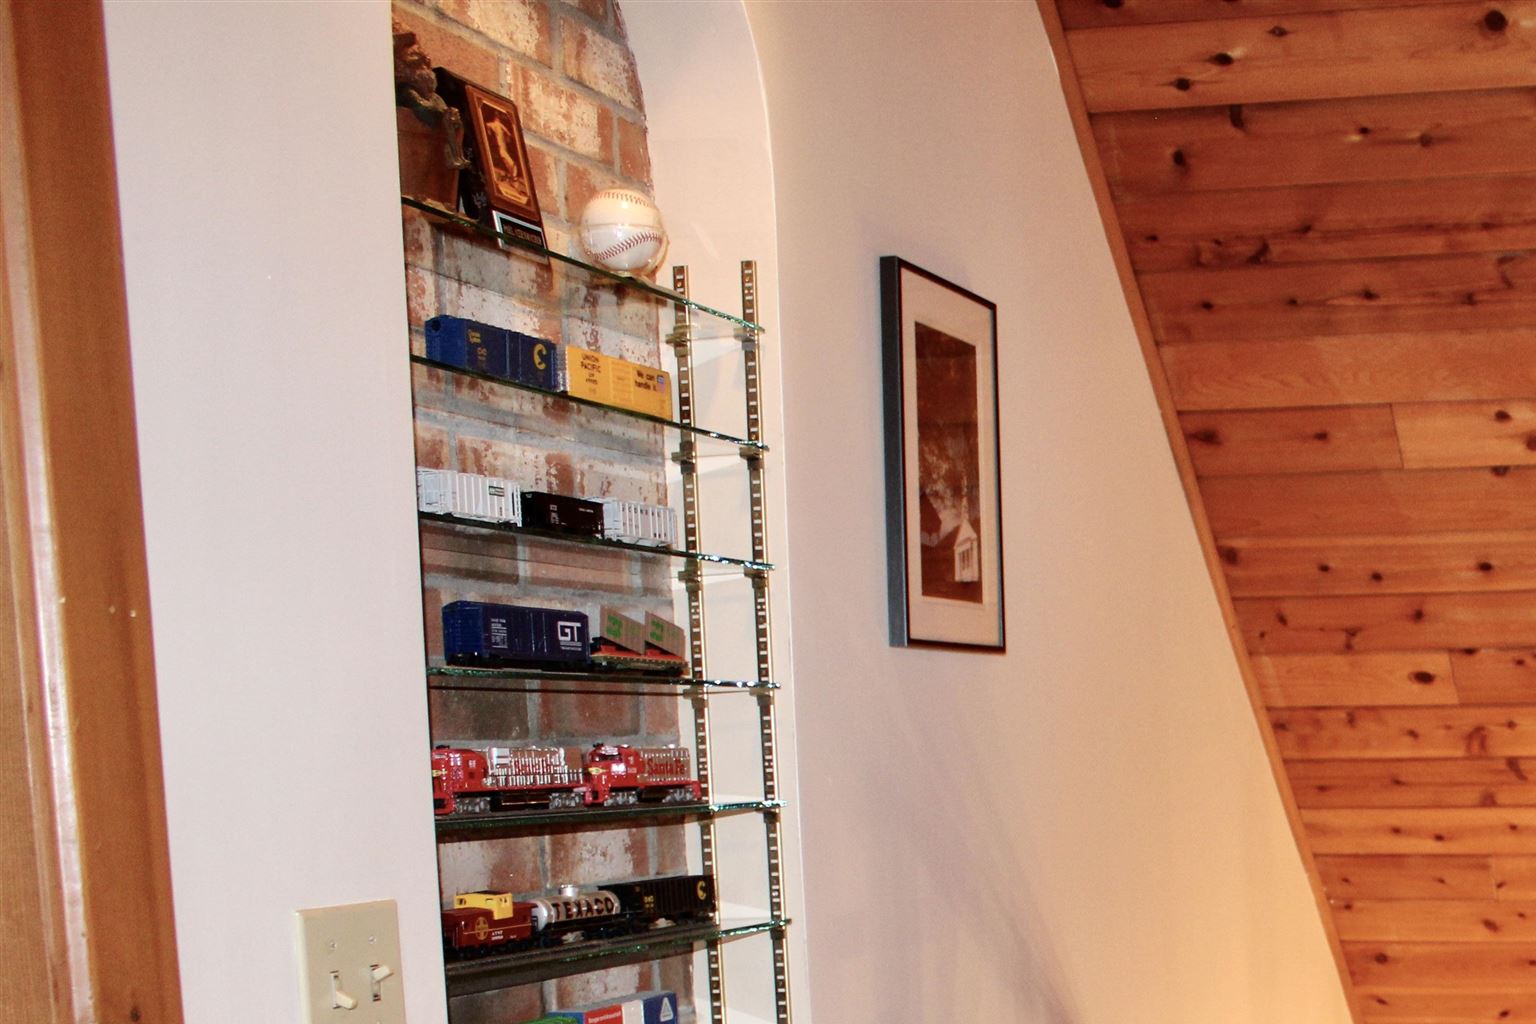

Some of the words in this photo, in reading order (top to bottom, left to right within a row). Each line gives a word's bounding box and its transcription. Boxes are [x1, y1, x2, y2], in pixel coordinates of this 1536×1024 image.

[581, 353, 600, 363] UNION
[580, 361, 601, 373] PACIFIC
[557, 621, 582, 642] GT
[647, 758, 674, 775] Santa
[675, 758, 686, 775] Fe
[552, 897, 615, 921] TEXACO
